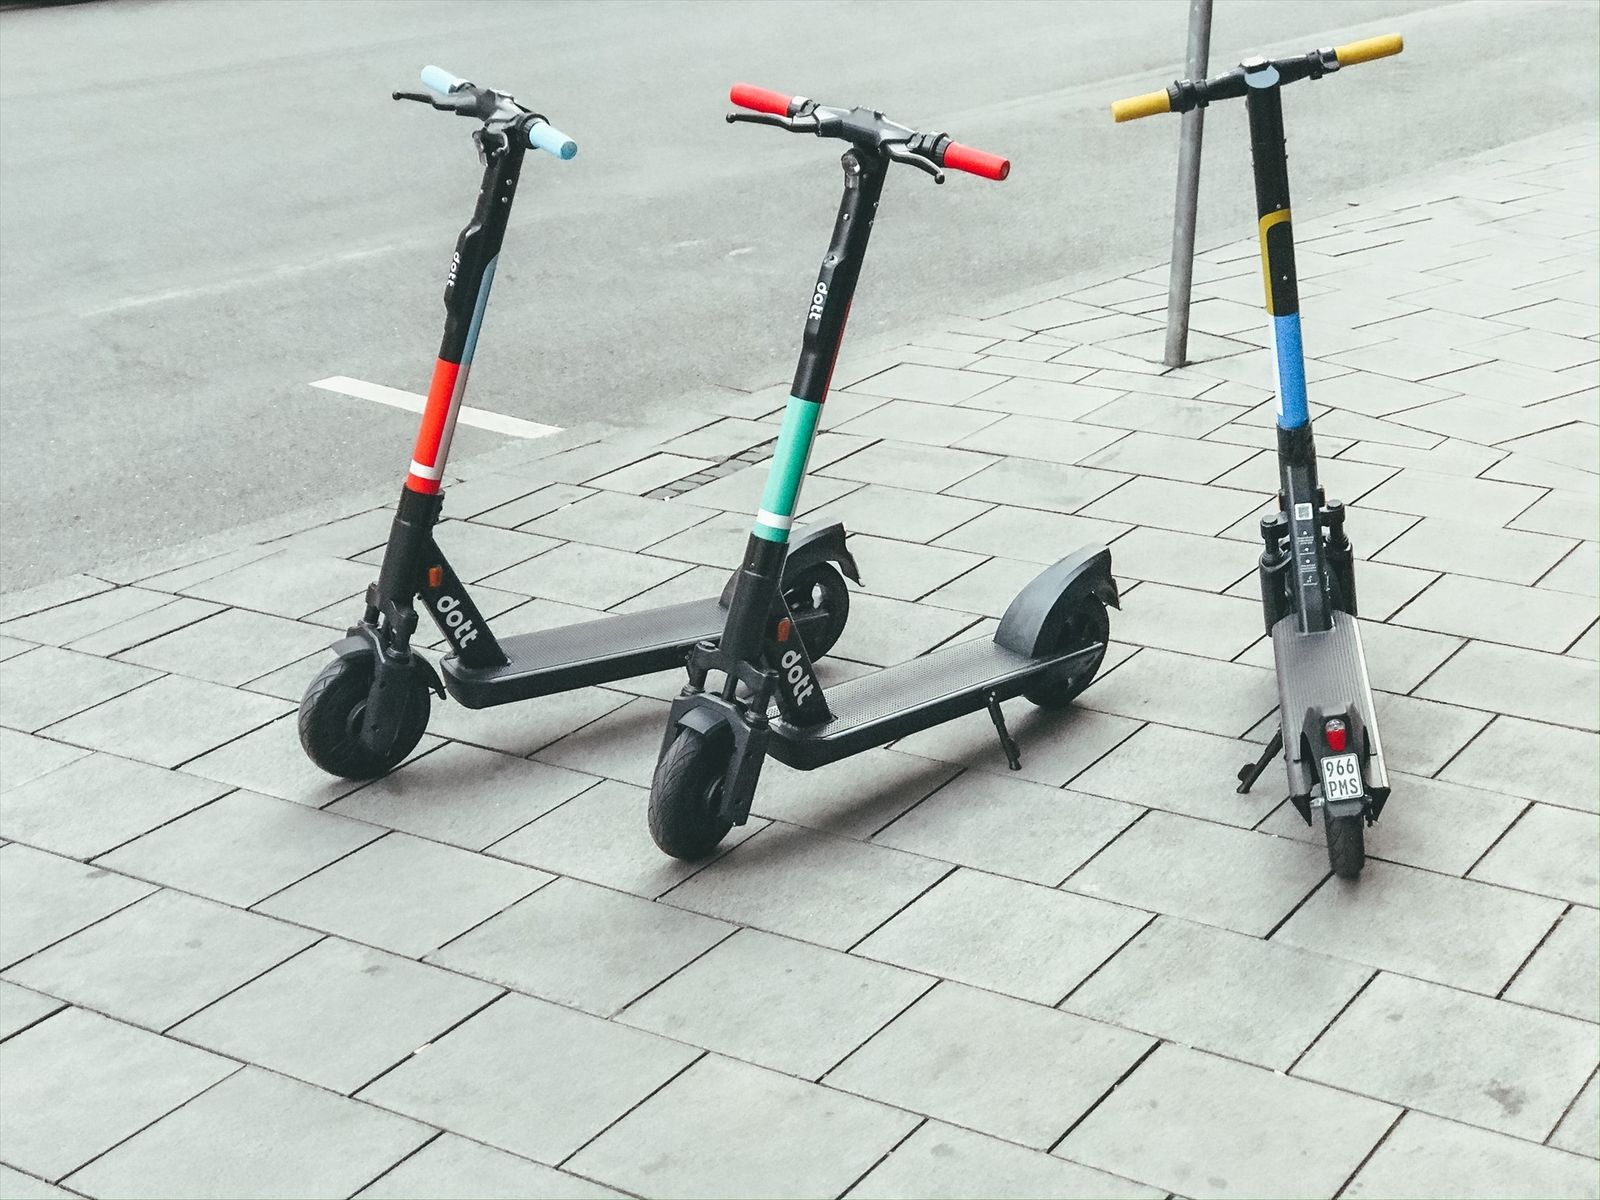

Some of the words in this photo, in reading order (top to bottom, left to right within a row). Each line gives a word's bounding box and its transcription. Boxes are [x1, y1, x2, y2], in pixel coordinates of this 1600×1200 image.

[447, 251, 460, 287] dott
[809, 281, 828, 320] dott
[436, 595, 478, 649] dott
[781, 650, 814, 706] dott
[1326, 758, 1354, 777] 966
[1328, 778, 1358, 797] PMS
